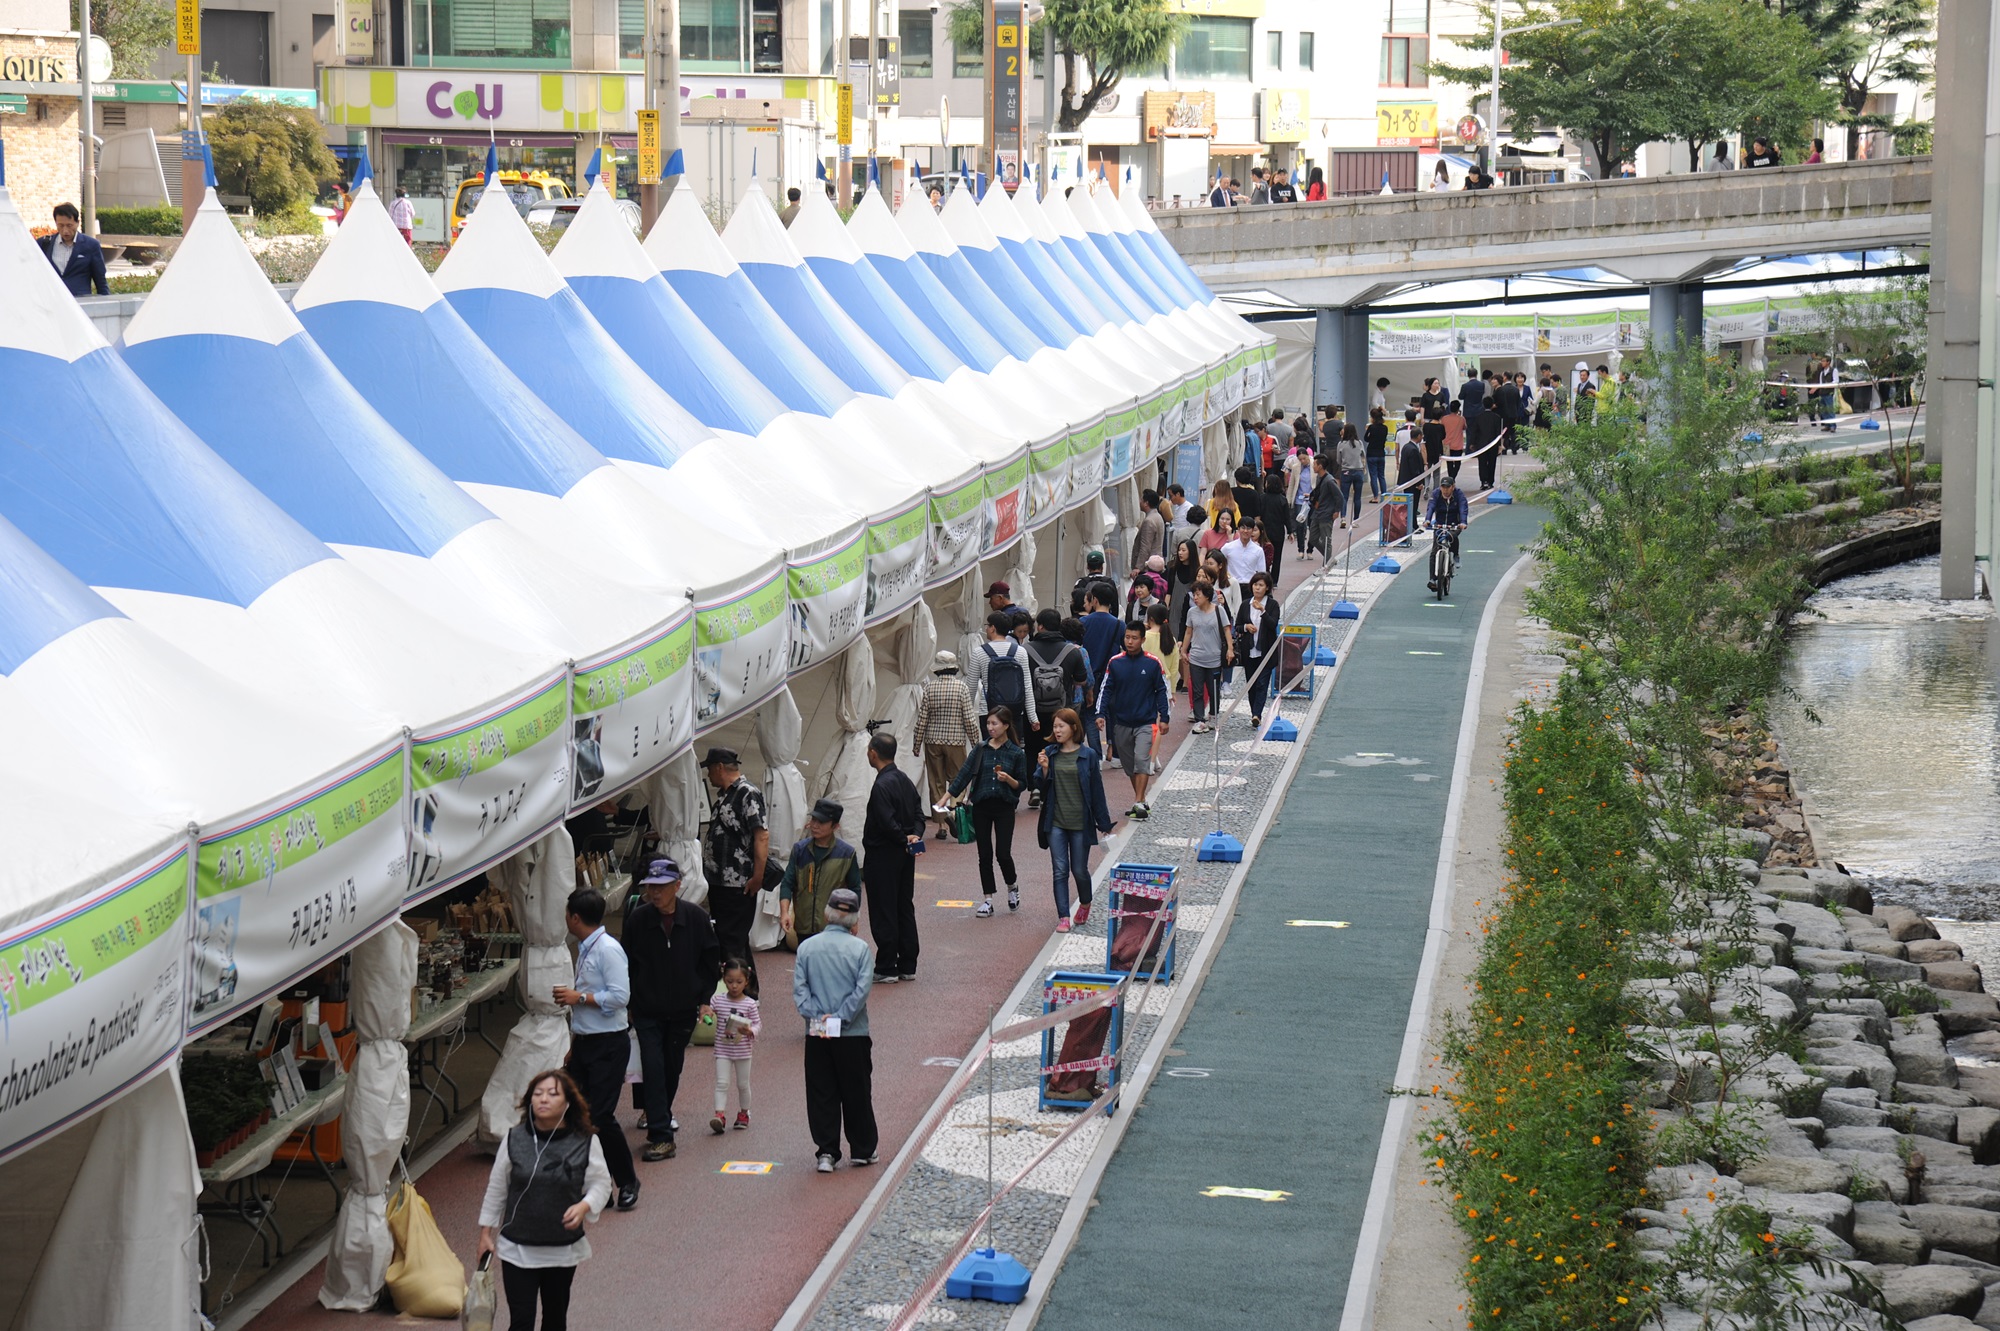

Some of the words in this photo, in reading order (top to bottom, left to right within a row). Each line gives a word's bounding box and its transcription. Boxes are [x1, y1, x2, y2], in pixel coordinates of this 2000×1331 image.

[350, 17, 371, 33] CU
[179, 43, 197, 52] CCTV
[0, 55, 67, 82] ours
[1006, 56, 1018, 76] 2
[426, 81, 503, 120] CU
[1007, 88, 1016, 120] 부산대
[1460, 122, 1476, 137] 회
[81, 1016, 97, 1070] &
[89, 991, 144, 1076] patissier
[1069, 1059, 1100, 1070] DANGER!
